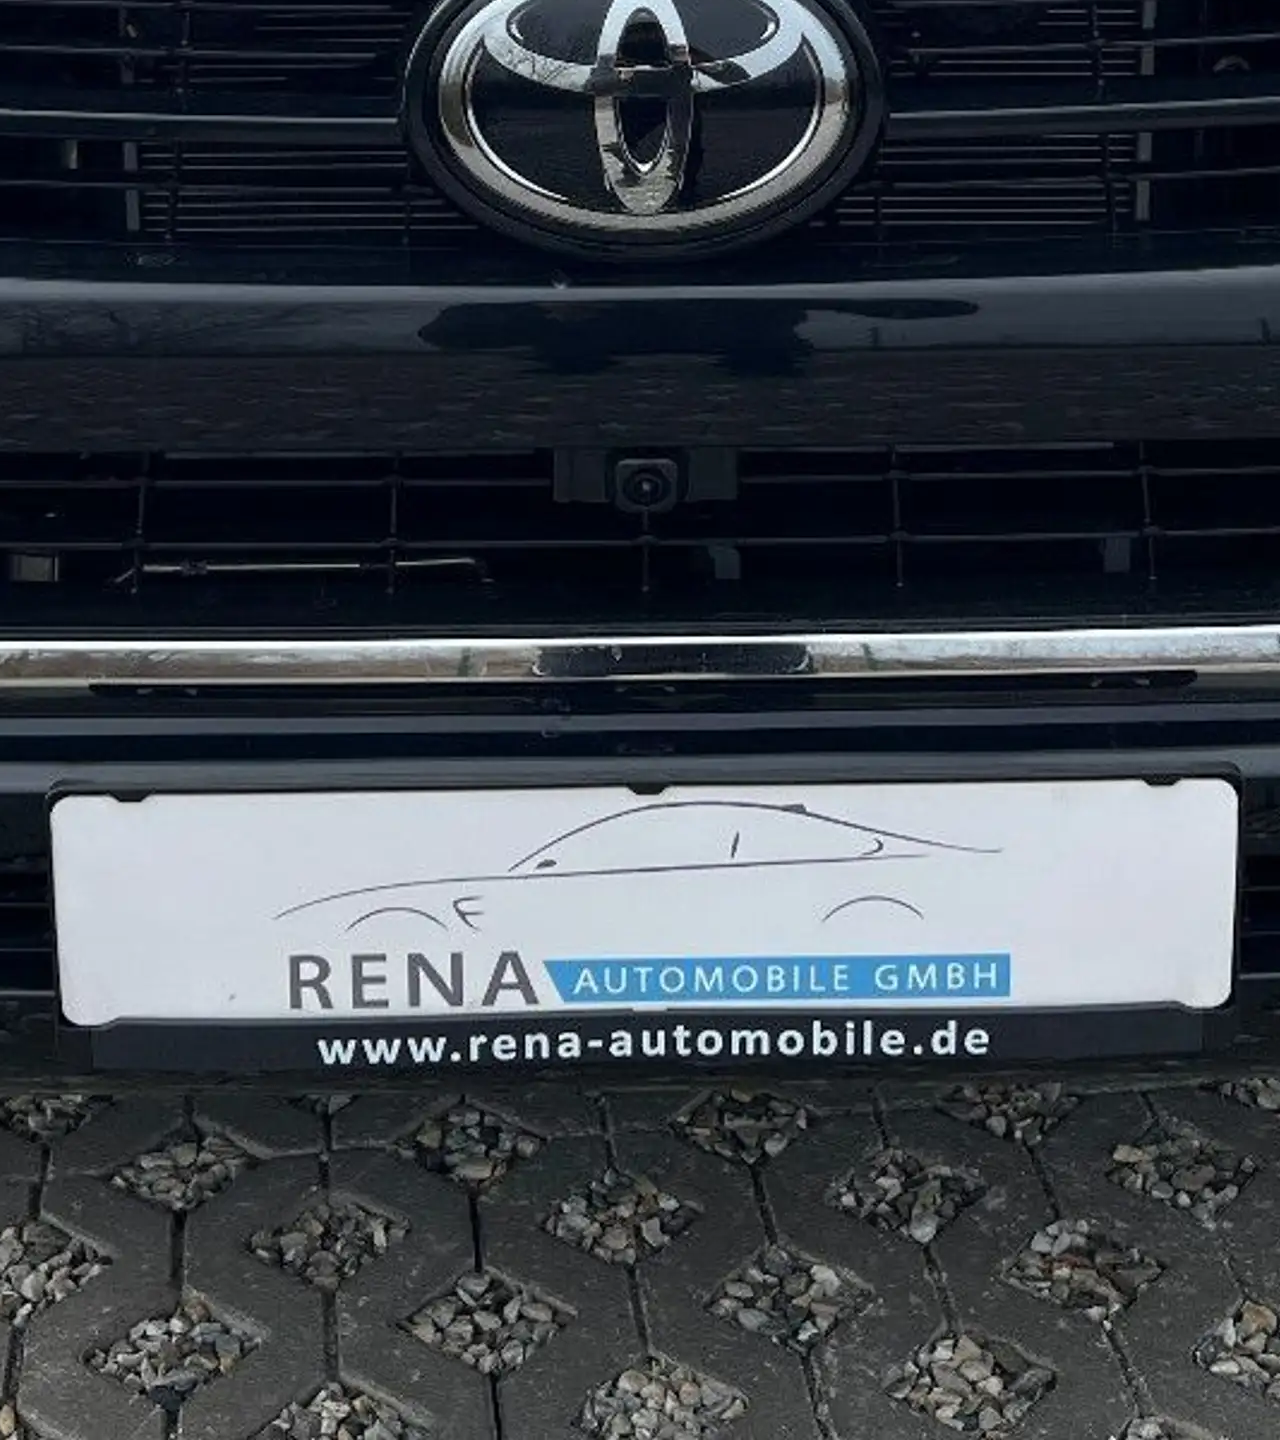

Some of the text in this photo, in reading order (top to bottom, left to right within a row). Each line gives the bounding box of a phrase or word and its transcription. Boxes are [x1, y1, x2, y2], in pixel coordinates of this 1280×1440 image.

[288, 950, 998, 1009] RENA AUTOMOBILE GMBH
[317, 1019, 991, 1065] www.rena-automobile.de
